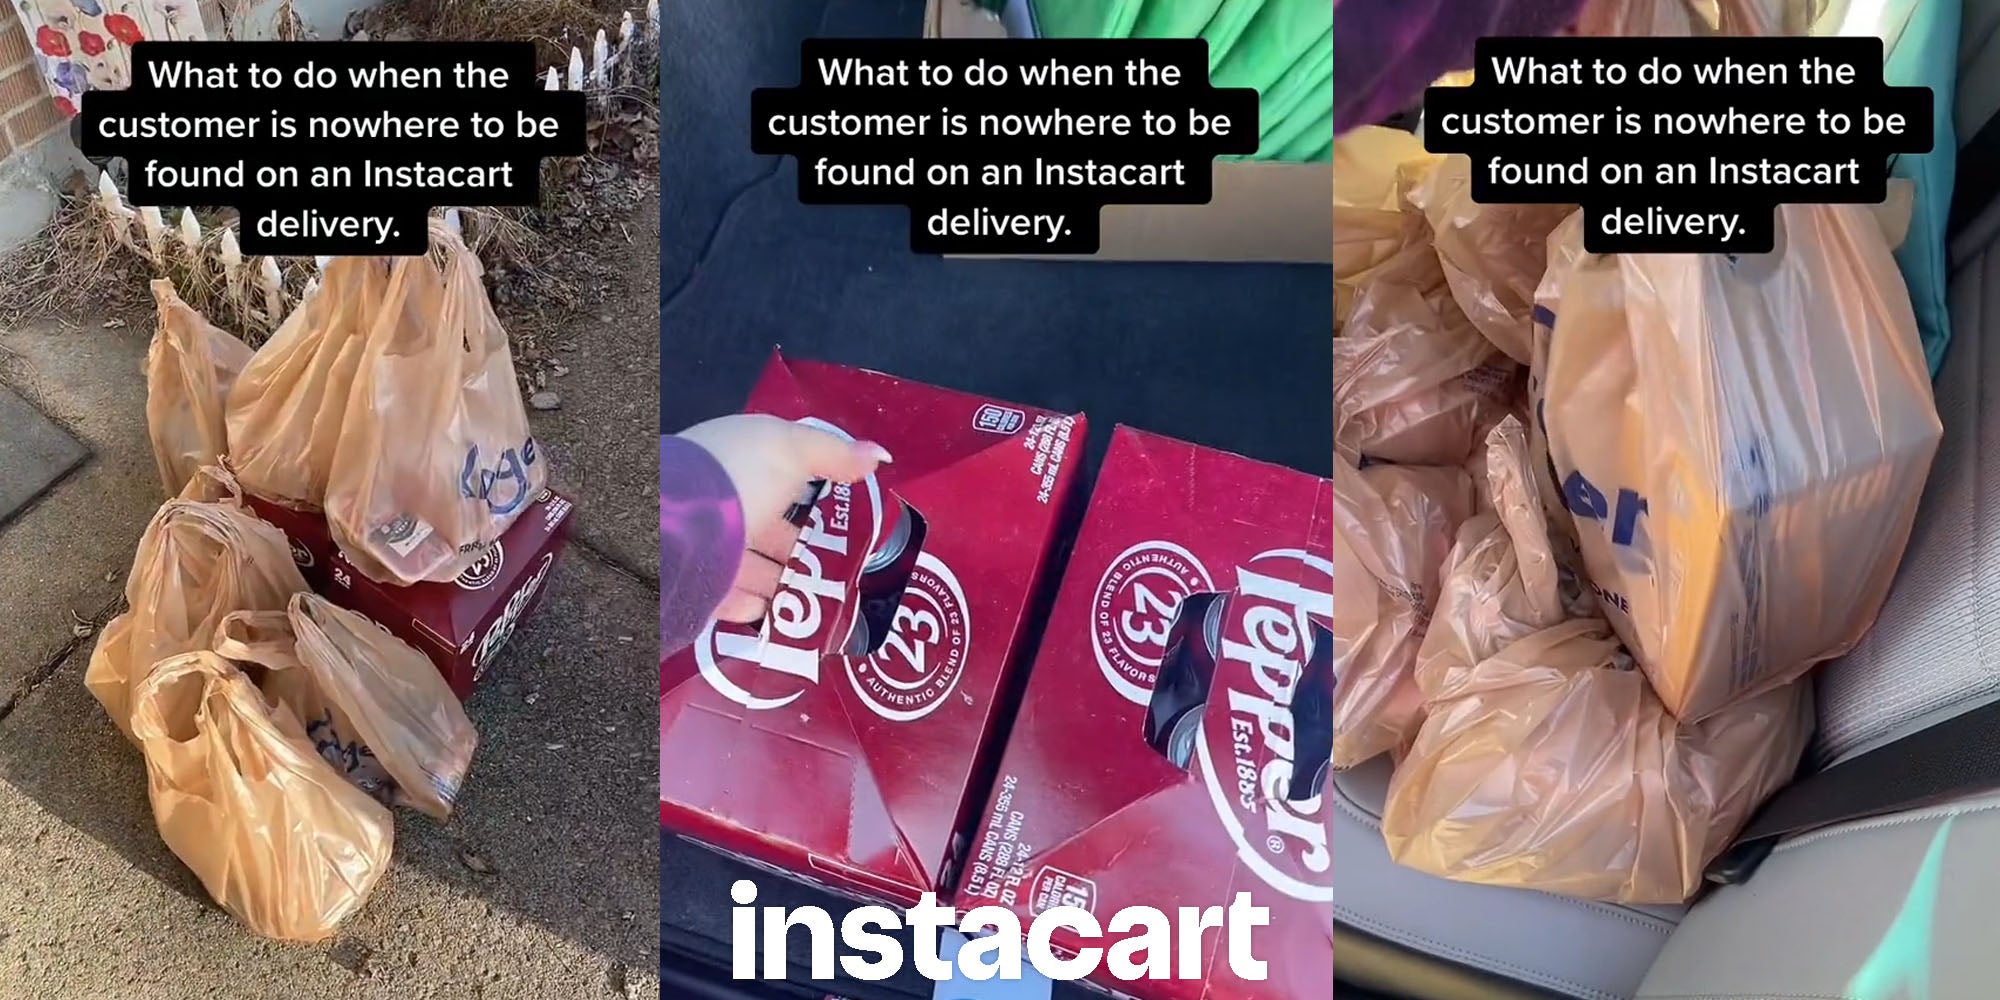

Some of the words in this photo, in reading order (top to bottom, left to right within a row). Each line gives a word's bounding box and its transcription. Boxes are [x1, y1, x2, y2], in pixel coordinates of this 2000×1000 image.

[979, 408, 1002, 427] 150
[1050, 439, 1067, 463] CANS
[1122, 554, 1190, 575] AUTHENTIC
[911, 572, 954, 608] FLAVORS
[1101, 572, 1123, 608] BLEND
[950, 611, 959, 625] 23
[1099, 612, 1109, 627] OF
[1122, 582, 1182, 646] 23
[878, 604, 940, 673] 23
[952, 630, 962, 644] OF
[1101, 631, 1113, 644] 23
[935, 651, 959, 689] BLEND
[1108, 648, 1156, 683] FLAVORS
[866, 677, 935, 705] AUTHENTIC
[995, 775, 1018, 812] 24-355
[988, 811, 1005, 829] mL
[1004, 810, 1024, 841] CANS
[979, 830, 999, 862] CANS
[995, 841, 1014, 869] (288
[1010, 842, 1031, 877] 24-12
[970, 861, 988, 884] (8.5
[989, 867, 1005, 884] FL
[1004, 875, 1021, 890] FL
[964, 883, 981, 896] L)
[980, 881, 1000, 898] OZ)
[1000, 889, 1017, 906] OZ
[1061, 883, 1089, 909] 15
